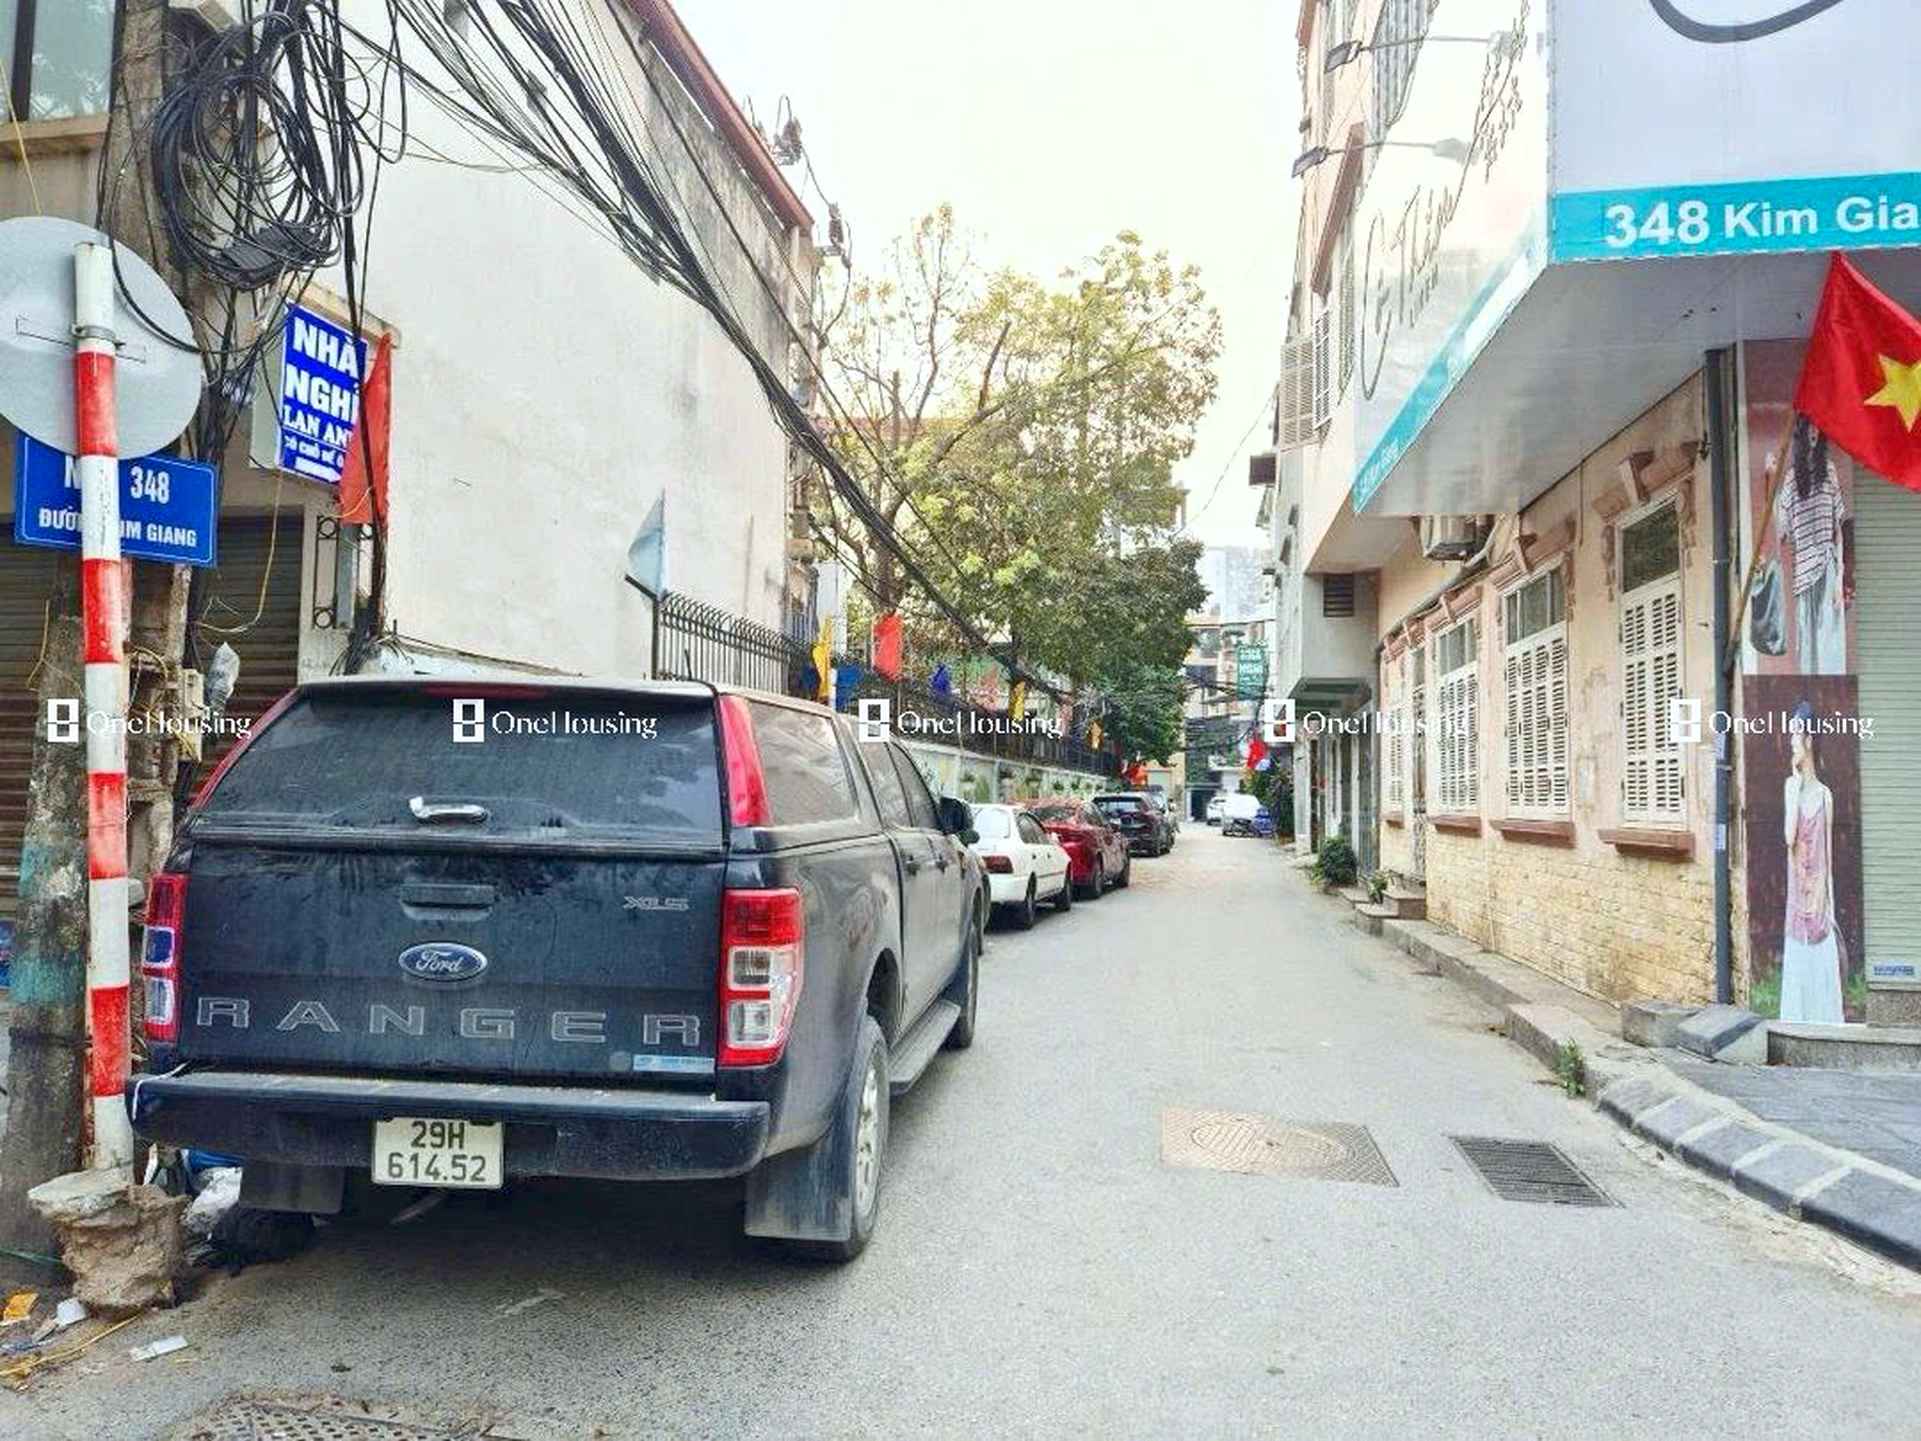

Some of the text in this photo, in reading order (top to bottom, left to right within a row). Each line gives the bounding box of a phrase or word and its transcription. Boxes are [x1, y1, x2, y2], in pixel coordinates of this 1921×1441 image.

[1604, 194, 1921, 248] 348 Kim Gia
[284, 404, 321, 438] LAN
[131, 465, 170, 504] 348
[38, 504, 197, 547] ĐƯỜ IM GIANG
[622, 895, 690, 912] XLS
[415, 949, 465, 974] Ford
[196, 996, 701, 1047] RANGER
[411, 1120, 465, 1150] 29H
[387, 1152, 487, 1182] 614.52
